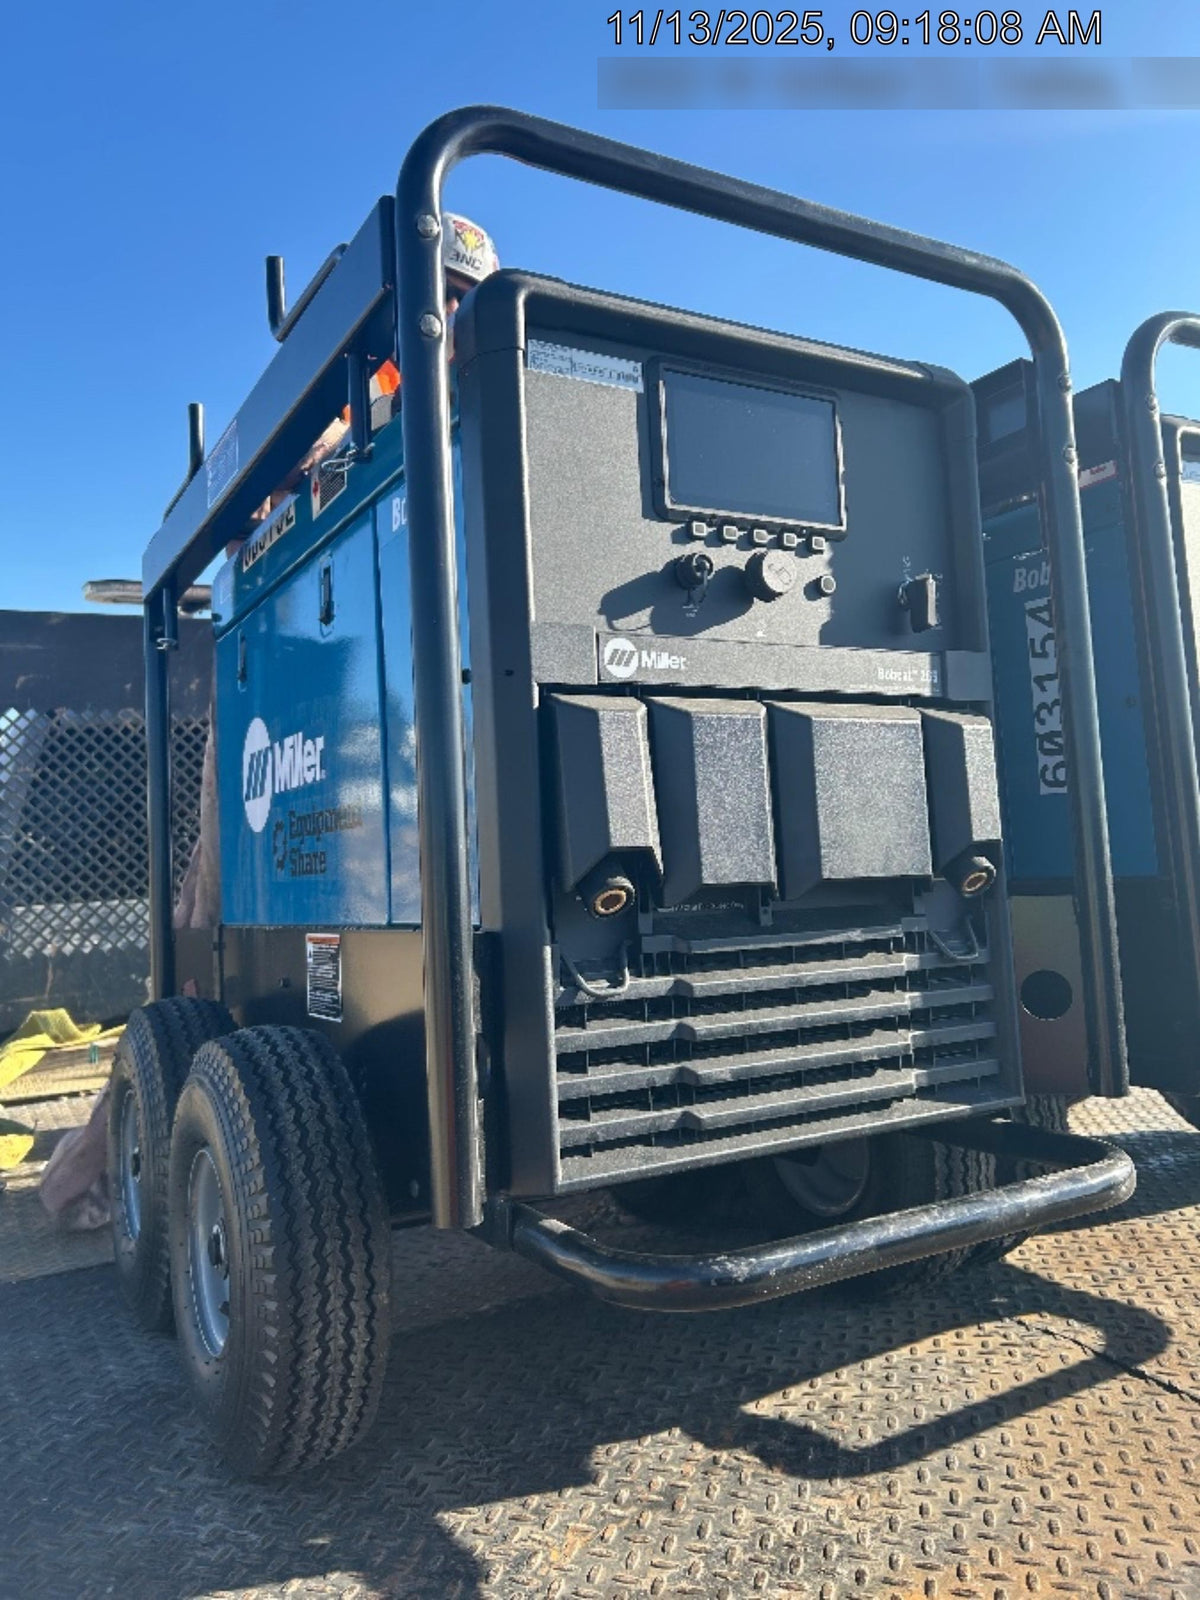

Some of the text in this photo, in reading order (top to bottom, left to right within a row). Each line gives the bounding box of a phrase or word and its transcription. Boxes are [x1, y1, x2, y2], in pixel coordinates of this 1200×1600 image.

[641, 650, 686, 670] Miller
[274, 732, 324, 793] Miller
[290, 848, 327, 876] Share
